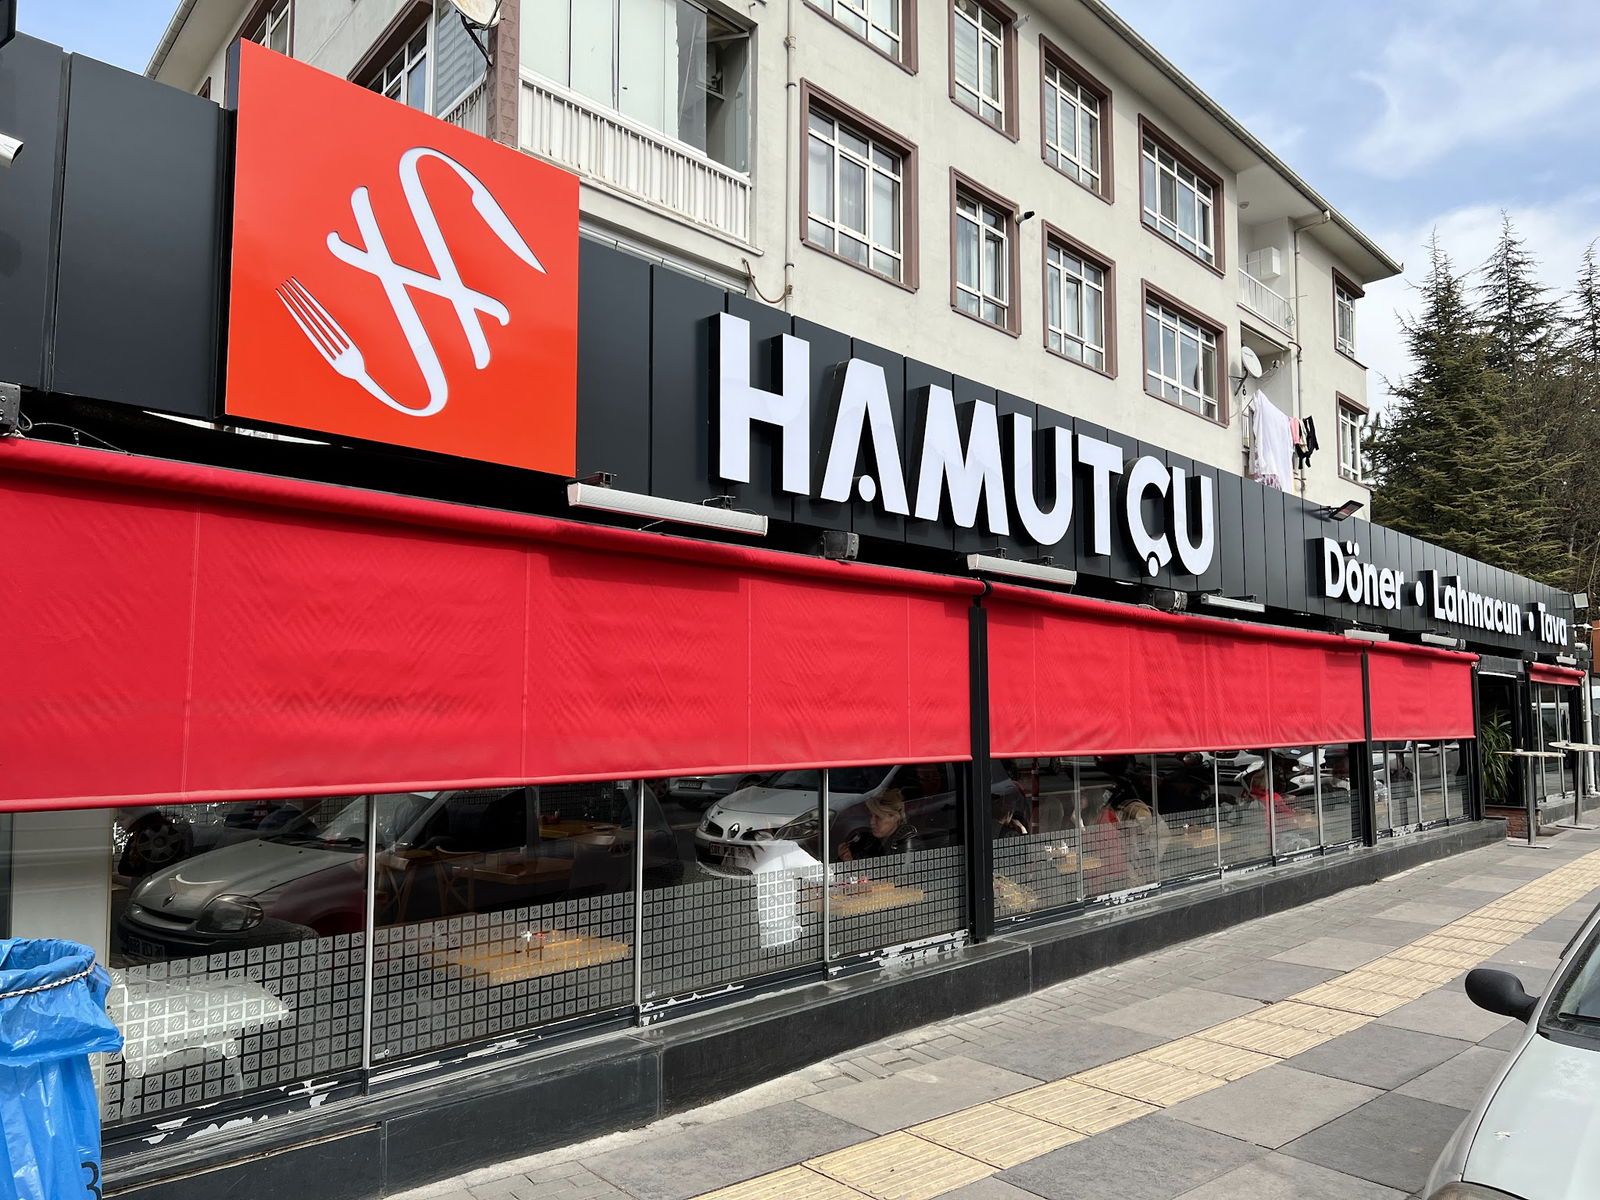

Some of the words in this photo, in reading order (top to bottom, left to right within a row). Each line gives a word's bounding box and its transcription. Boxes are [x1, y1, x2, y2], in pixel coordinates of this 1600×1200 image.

[719, 311, 1214, 578] HAMUTÇU
[1323, 537, 1404, 610] Döner
[1432, 569, 1522, 636] Lahmacun
[1537, 601, 1568, 646] Tava
